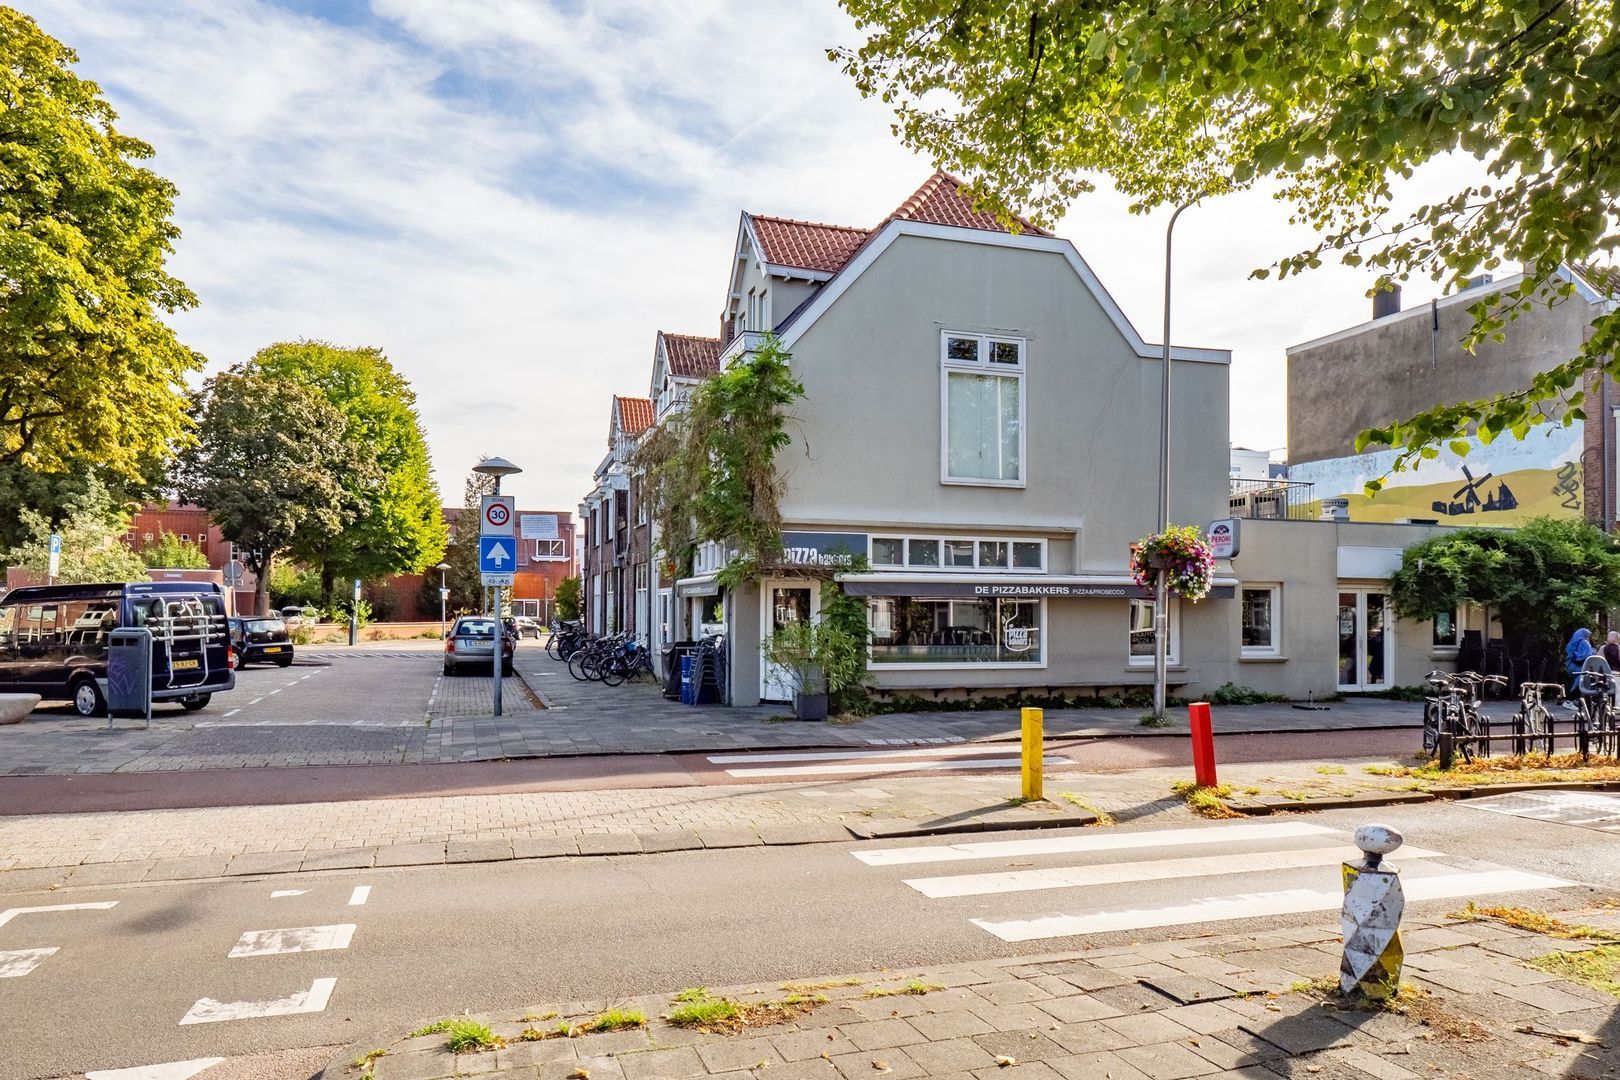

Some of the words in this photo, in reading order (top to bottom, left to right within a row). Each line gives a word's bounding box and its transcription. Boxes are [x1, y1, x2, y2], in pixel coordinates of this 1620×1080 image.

[491, 510, 505, 519] 30
[1211, 535, 1231, 543] PERONI
[975, 586, 989, 594] DE
[992, 586, 1070, 595] PIZZABAKKERS
